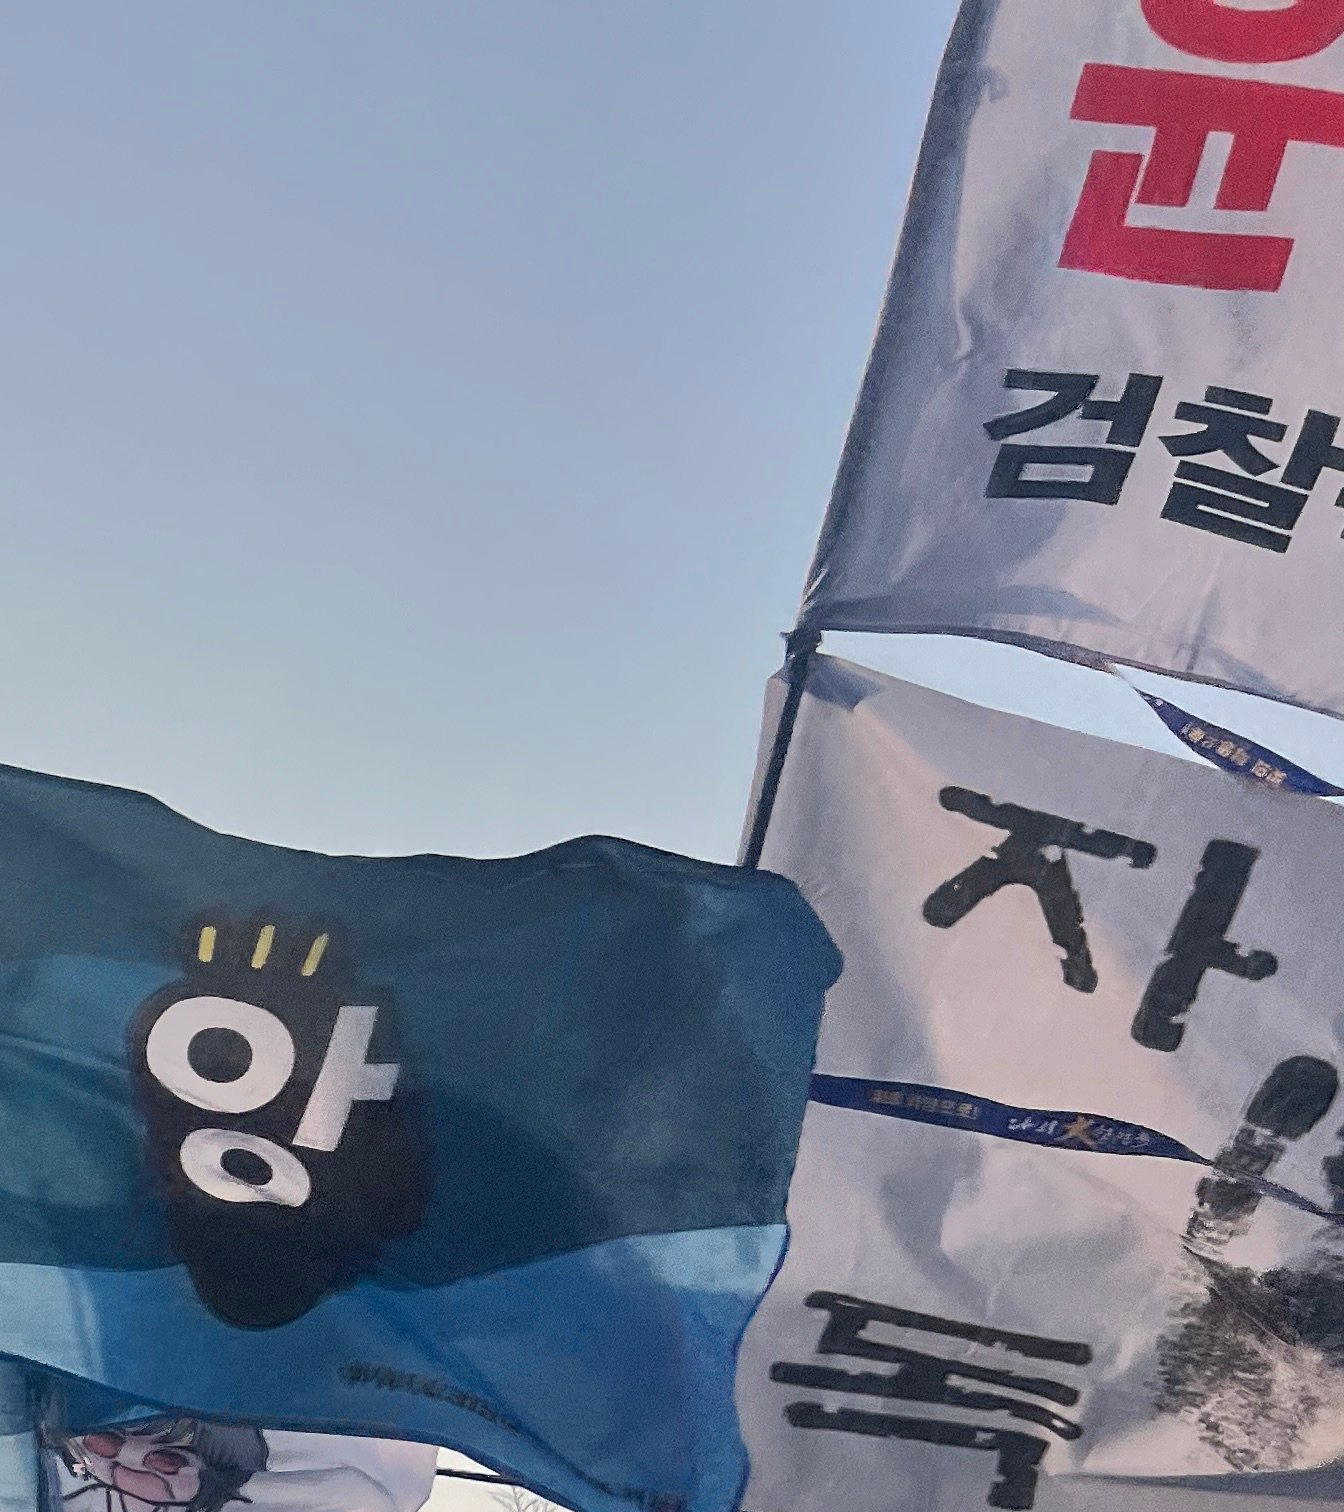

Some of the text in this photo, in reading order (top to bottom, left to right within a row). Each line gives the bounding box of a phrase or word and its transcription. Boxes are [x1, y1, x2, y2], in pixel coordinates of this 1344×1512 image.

[983, 368, 1344, 554] 검찰
[923, 784, 1277, 1052] 자
[145, 995, 400, 1209] 앙
[769, 1290, 1093, 1511] 독
